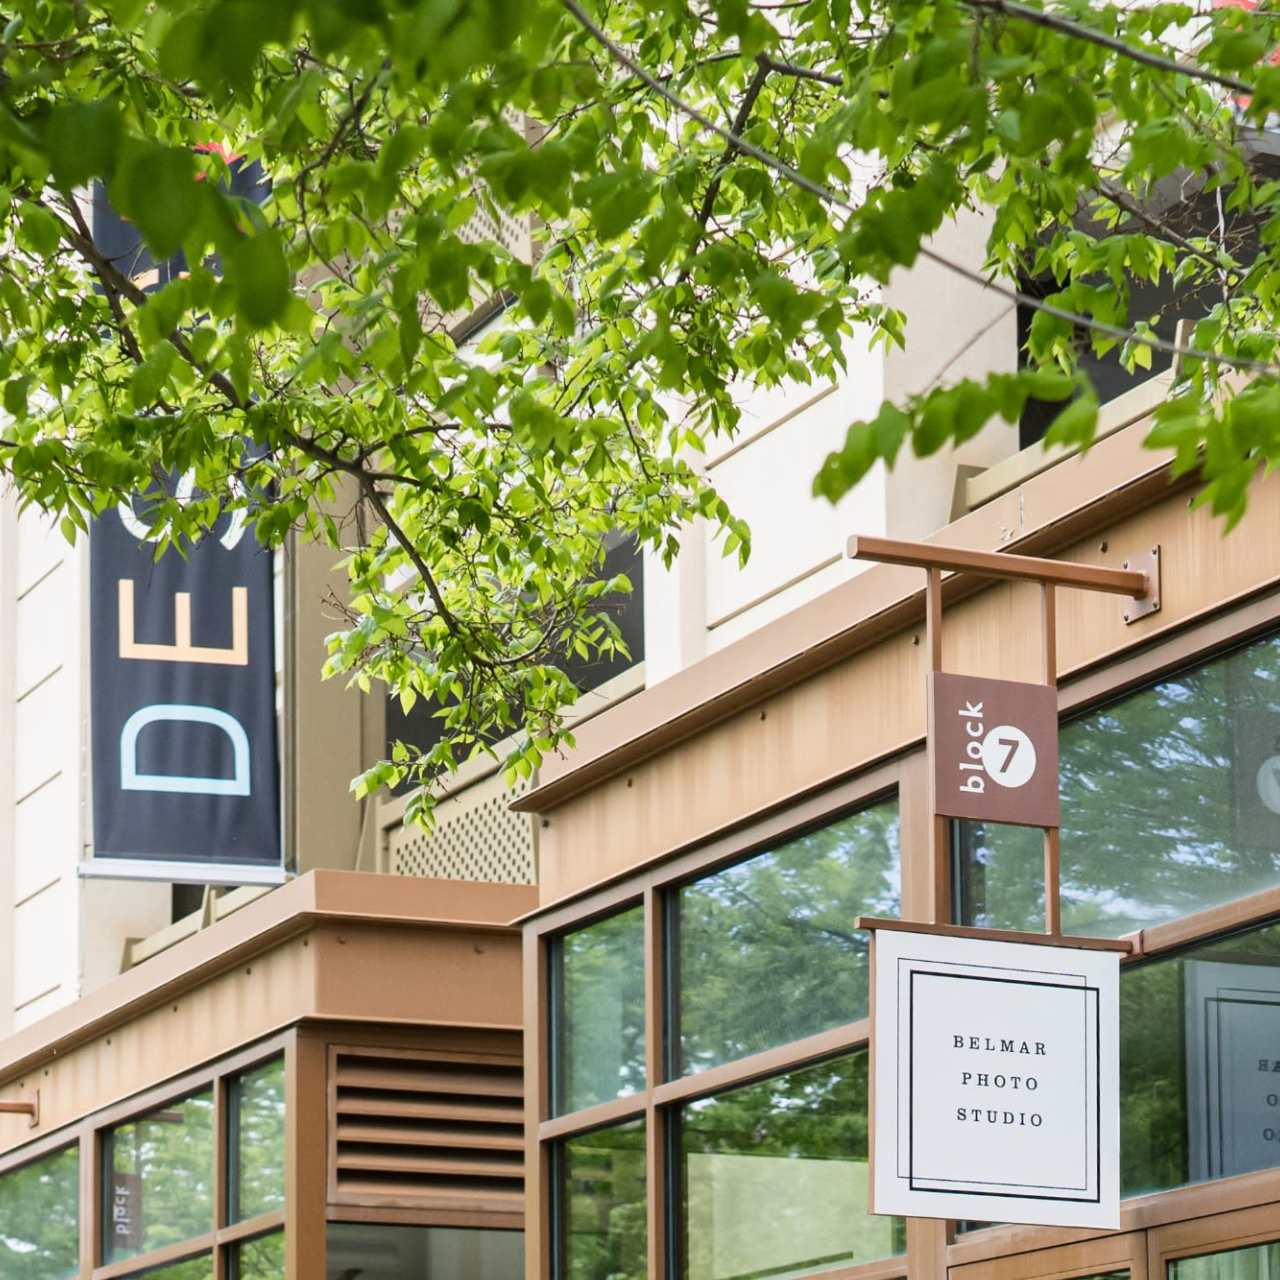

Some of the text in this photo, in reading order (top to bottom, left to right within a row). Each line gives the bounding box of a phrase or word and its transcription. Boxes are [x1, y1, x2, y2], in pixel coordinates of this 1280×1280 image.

[958, 700, 1020, 794] block 7
[953, 1035, 1046, 1055] BELMAR
[962, 1072, 1038, 1090] PHOTO
[957, 1108, 1042, 1127] STUDIO
